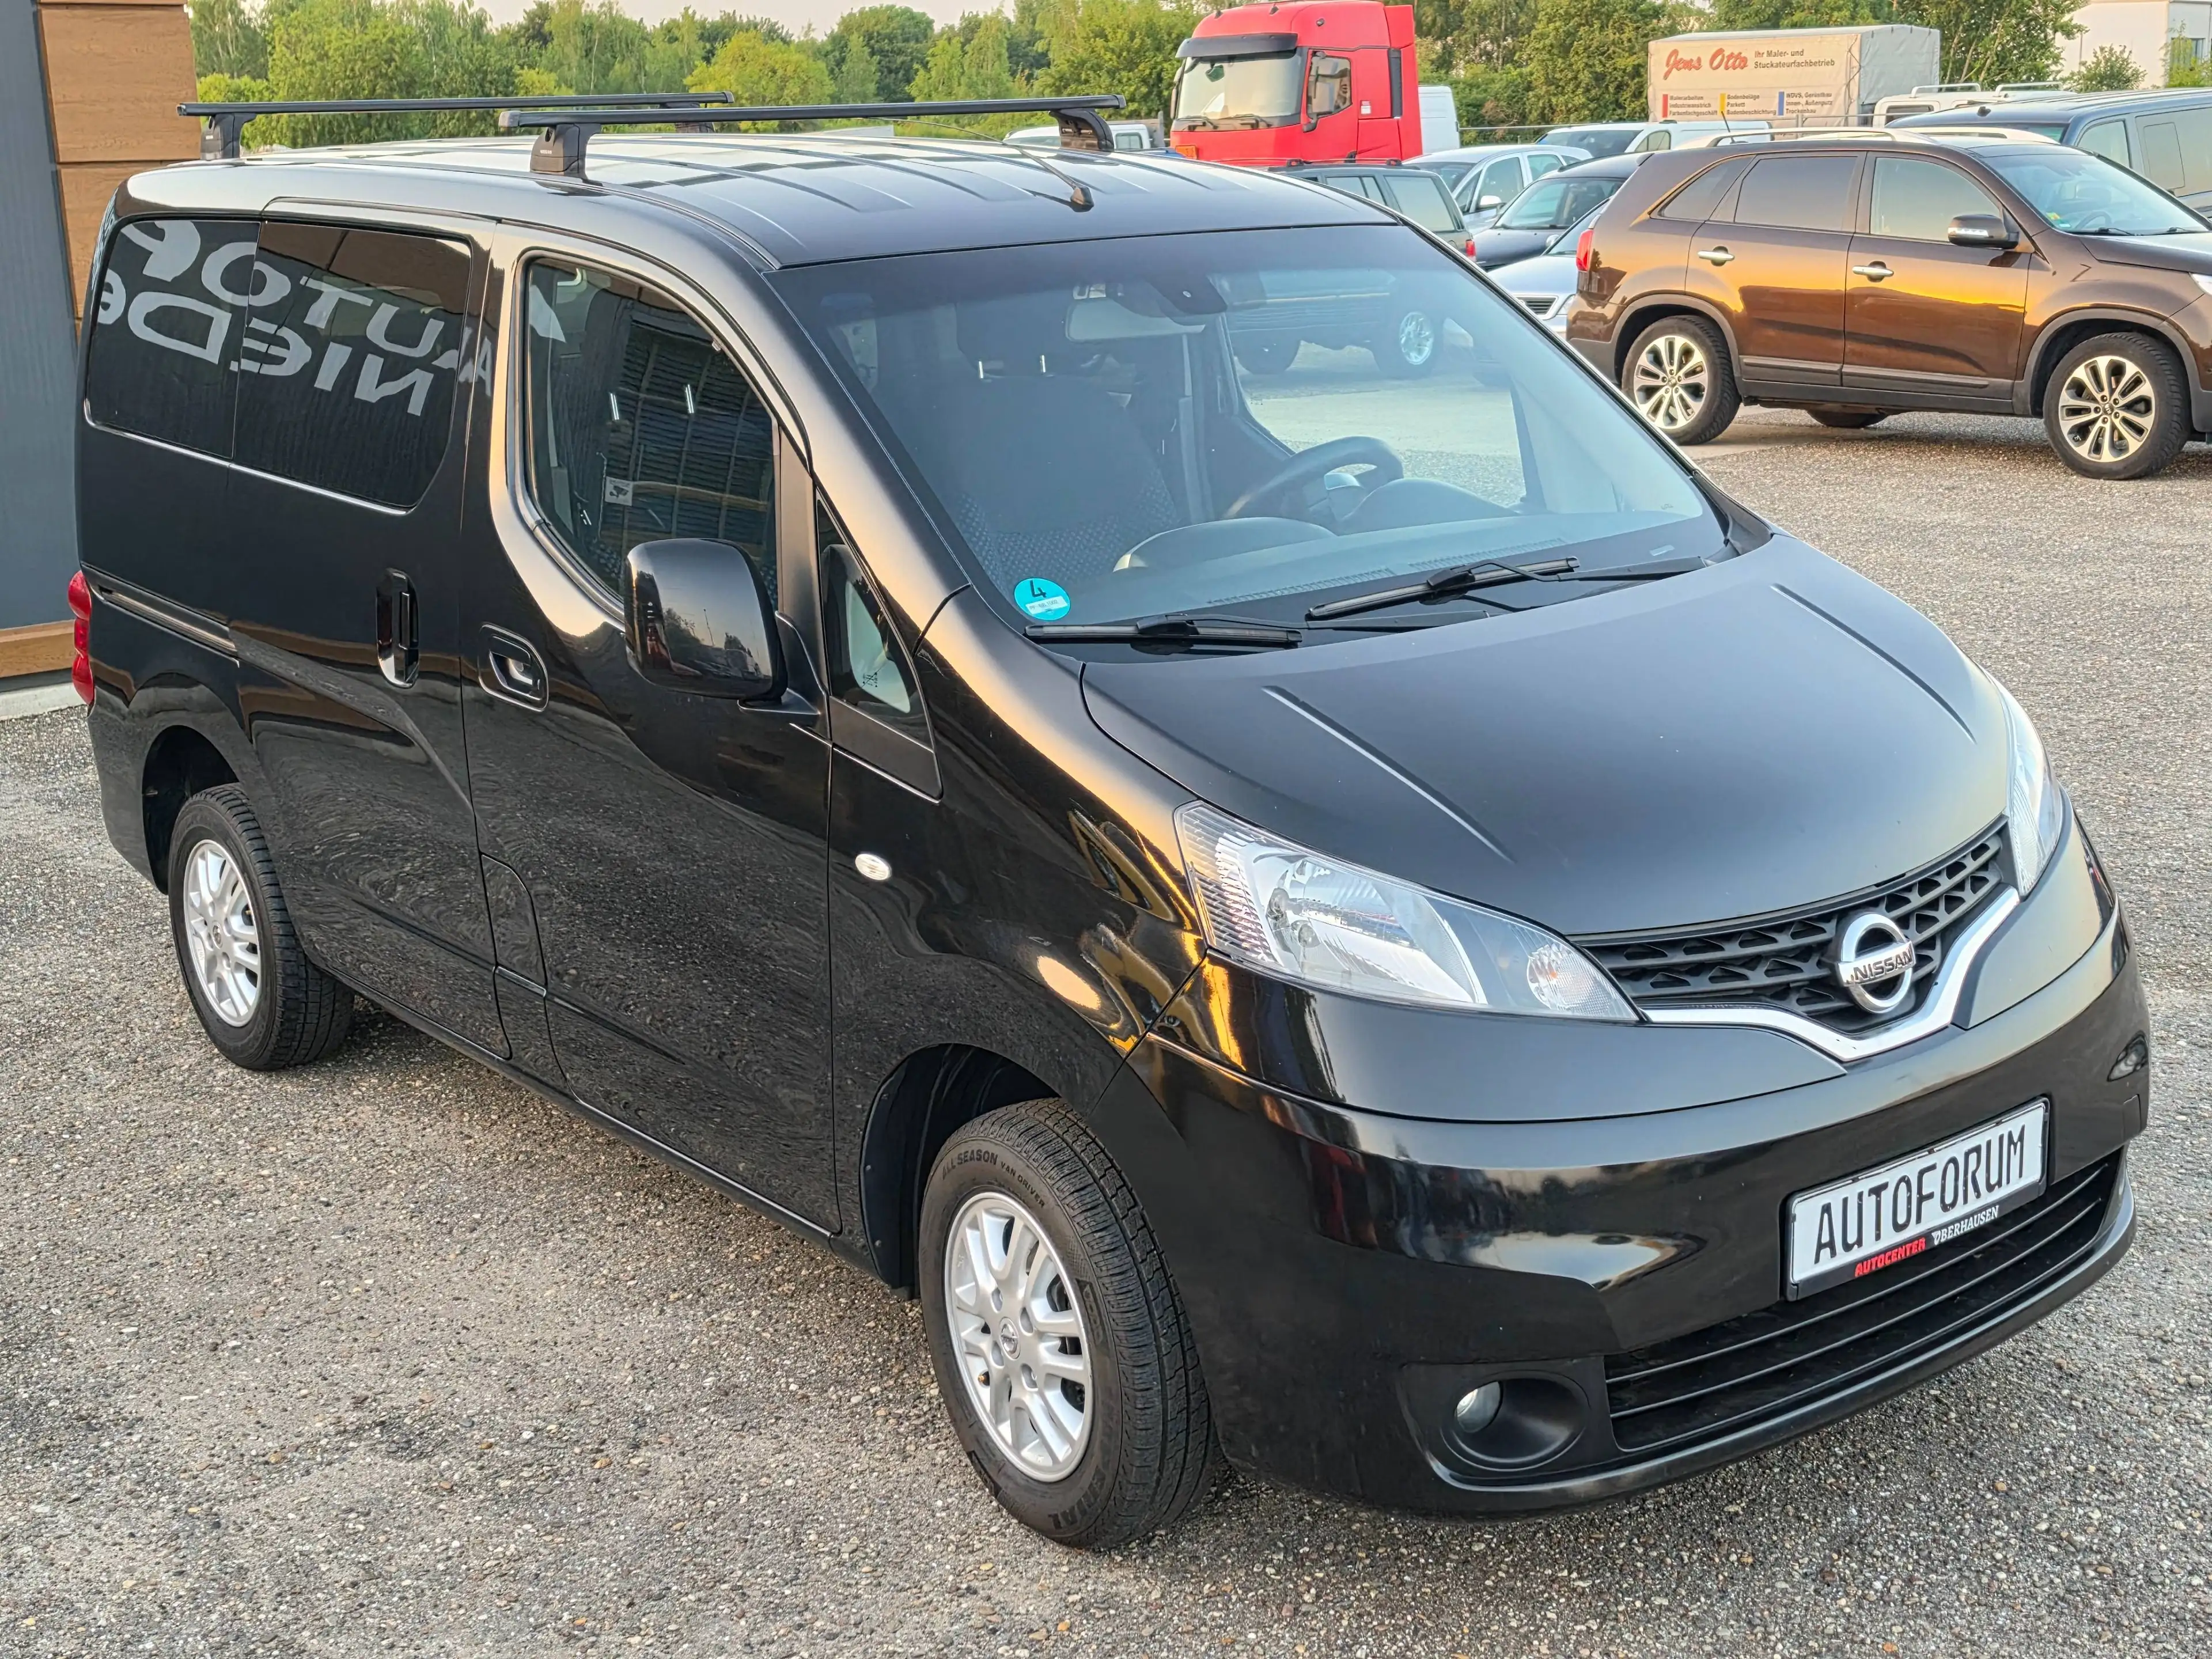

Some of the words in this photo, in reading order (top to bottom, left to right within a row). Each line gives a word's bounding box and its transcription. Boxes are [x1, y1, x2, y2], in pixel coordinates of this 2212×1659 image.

[1662, 48, 1703, 81] Jens
[1709, 47, 1748, 71] Otto
[1753, 58, 1835, 69] Stuckateurfachbetrieb
[1754, 50, 1765, 58] Ihr
[1766, 50, 1789, 58] Maler-
[1790, 48, 1804, 56] und
[1029, 579, 1047, 598] 4
[1853, 946, 1913, 982] NISSAN
[942, 1158, 957, 1180] ALL
[956, 1149, 998, 1166] SEASON
[1001, 1161, 1016, 1177] VAN
[1017, 1174, 1046, 1209] DRIVER
[1814, 1123, 2025, 1264] AUTOFORUM
[1854, 1237, 1926, 1278] AUTOCENTER
[1931, 1205, 1999, 1245] OBERHAUSEN
